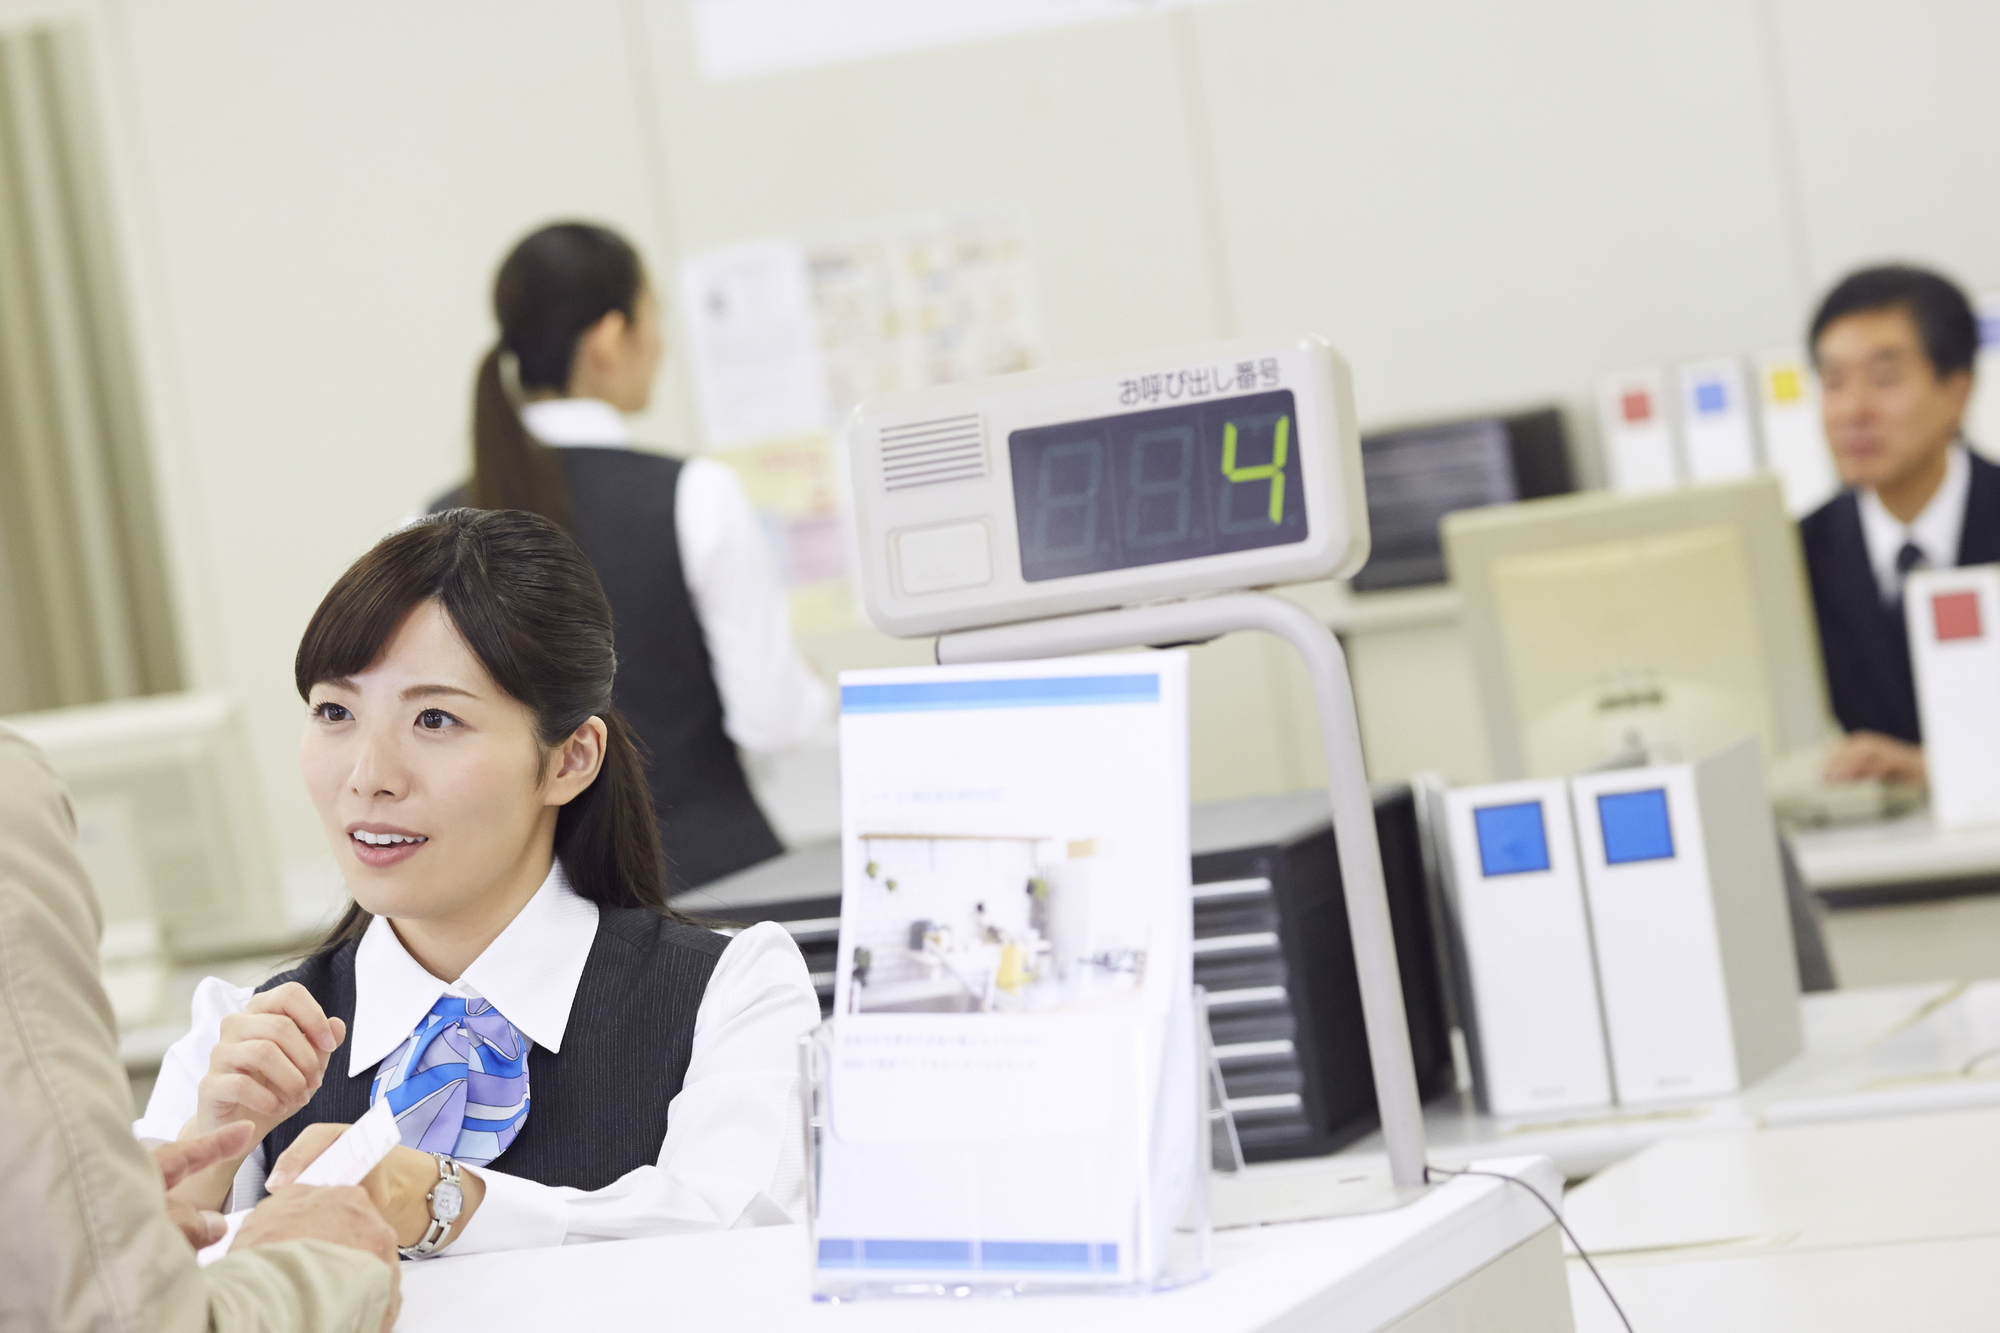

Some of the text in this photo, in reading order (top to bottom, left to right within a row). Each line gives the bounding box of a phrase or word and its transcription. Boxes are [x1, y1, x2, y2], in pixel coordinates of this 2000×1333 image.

[1119, 357, 1281, 405] お呼び出し番号
[1221, 415, 1289, 525] 4
